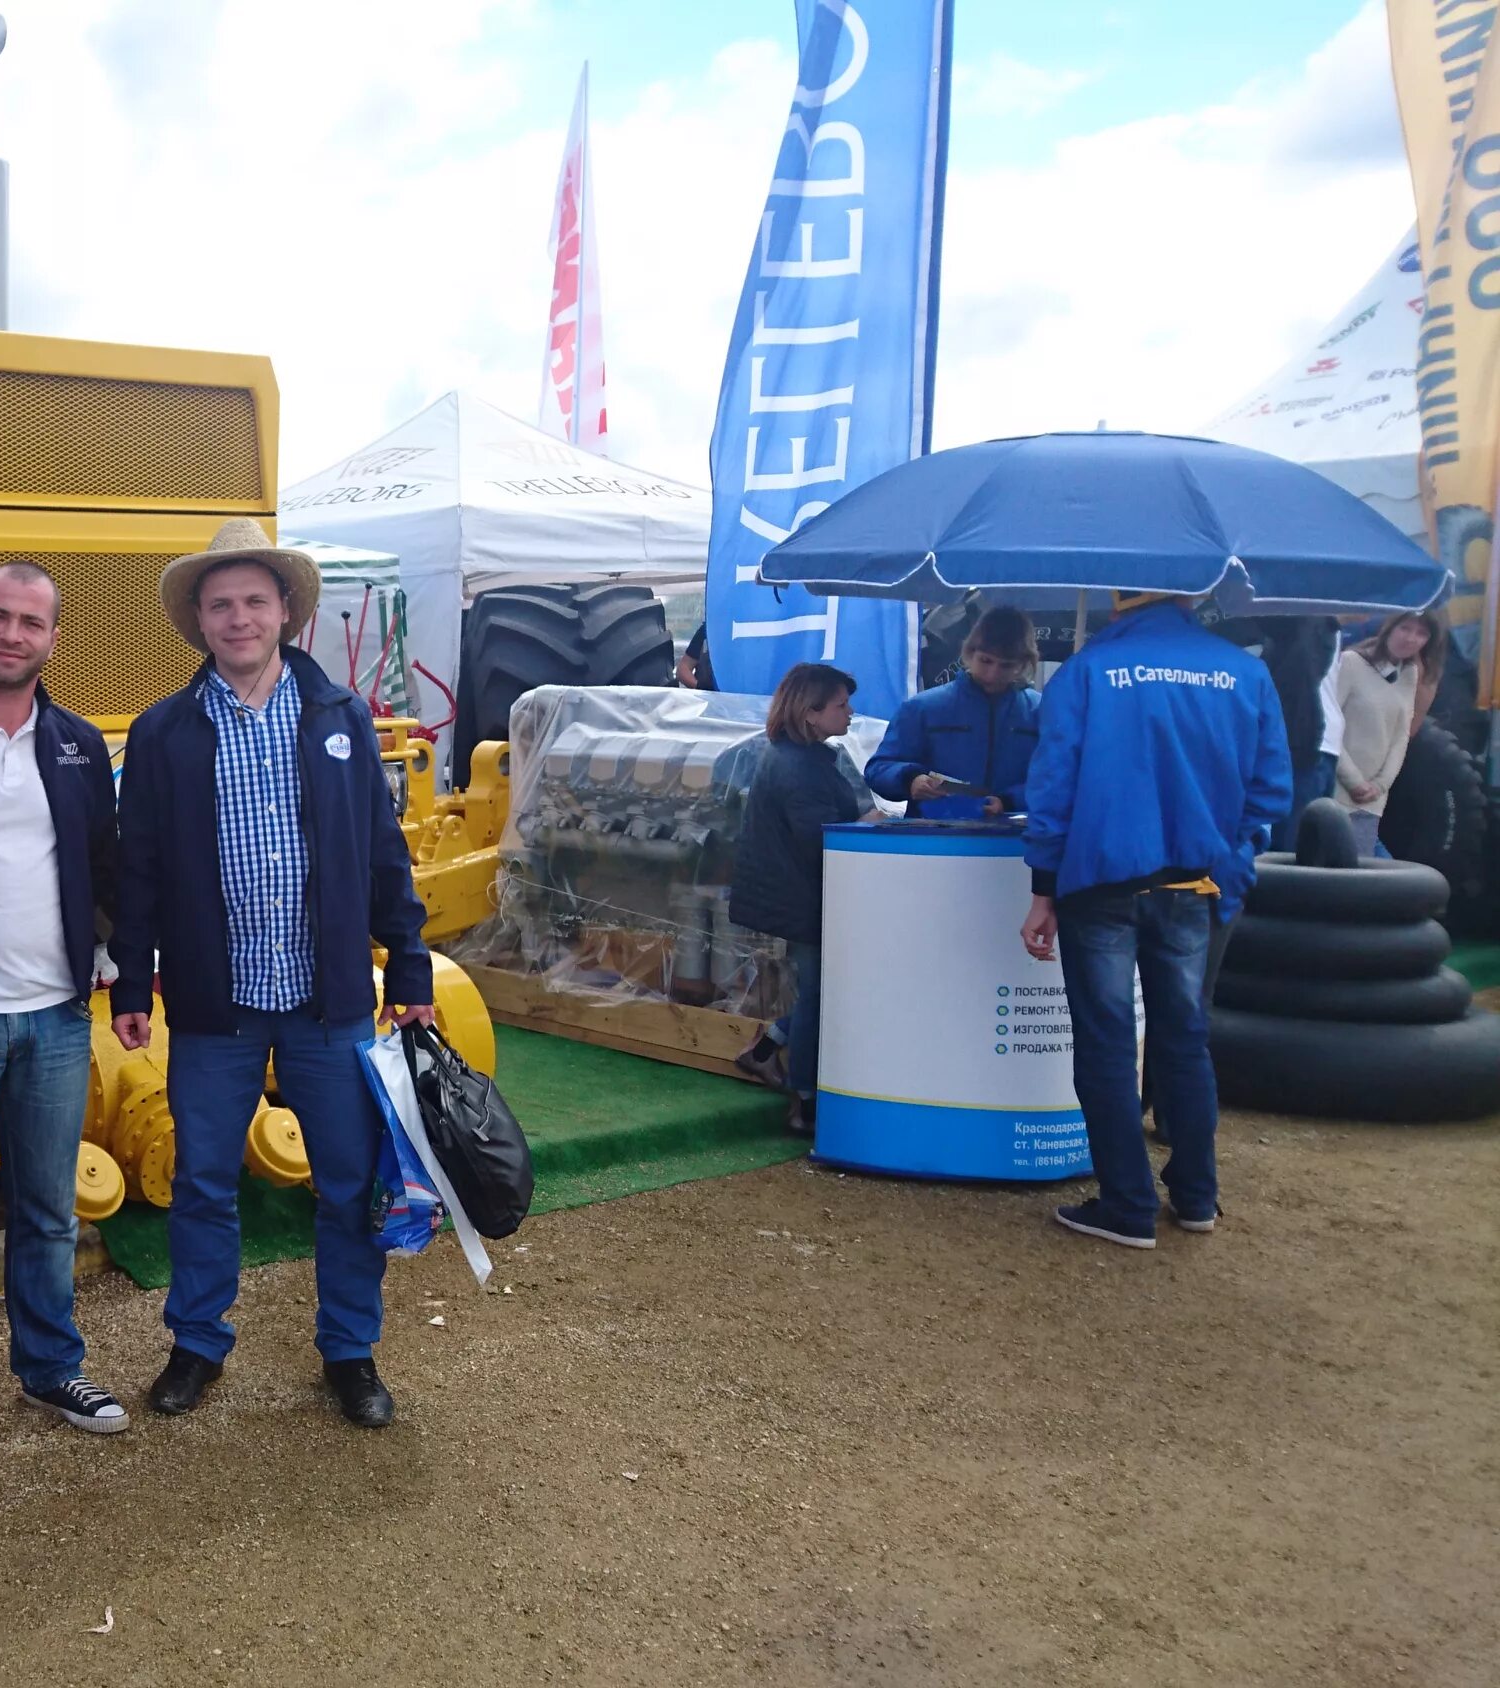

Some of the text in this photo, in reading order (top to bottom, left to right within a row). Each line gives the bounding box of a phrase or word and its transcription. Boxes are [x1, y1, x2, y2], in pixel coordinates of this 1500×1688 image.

[1105, 665, 1238, 690] ТД Сателлит-Юг
[1014, 1005, 1071, 1016] РЕМОНТ УЗ
[1013, 1044, 1063, 1055] ПРОДАЖА
[1013, 1140, 1030, 1150] ст.
